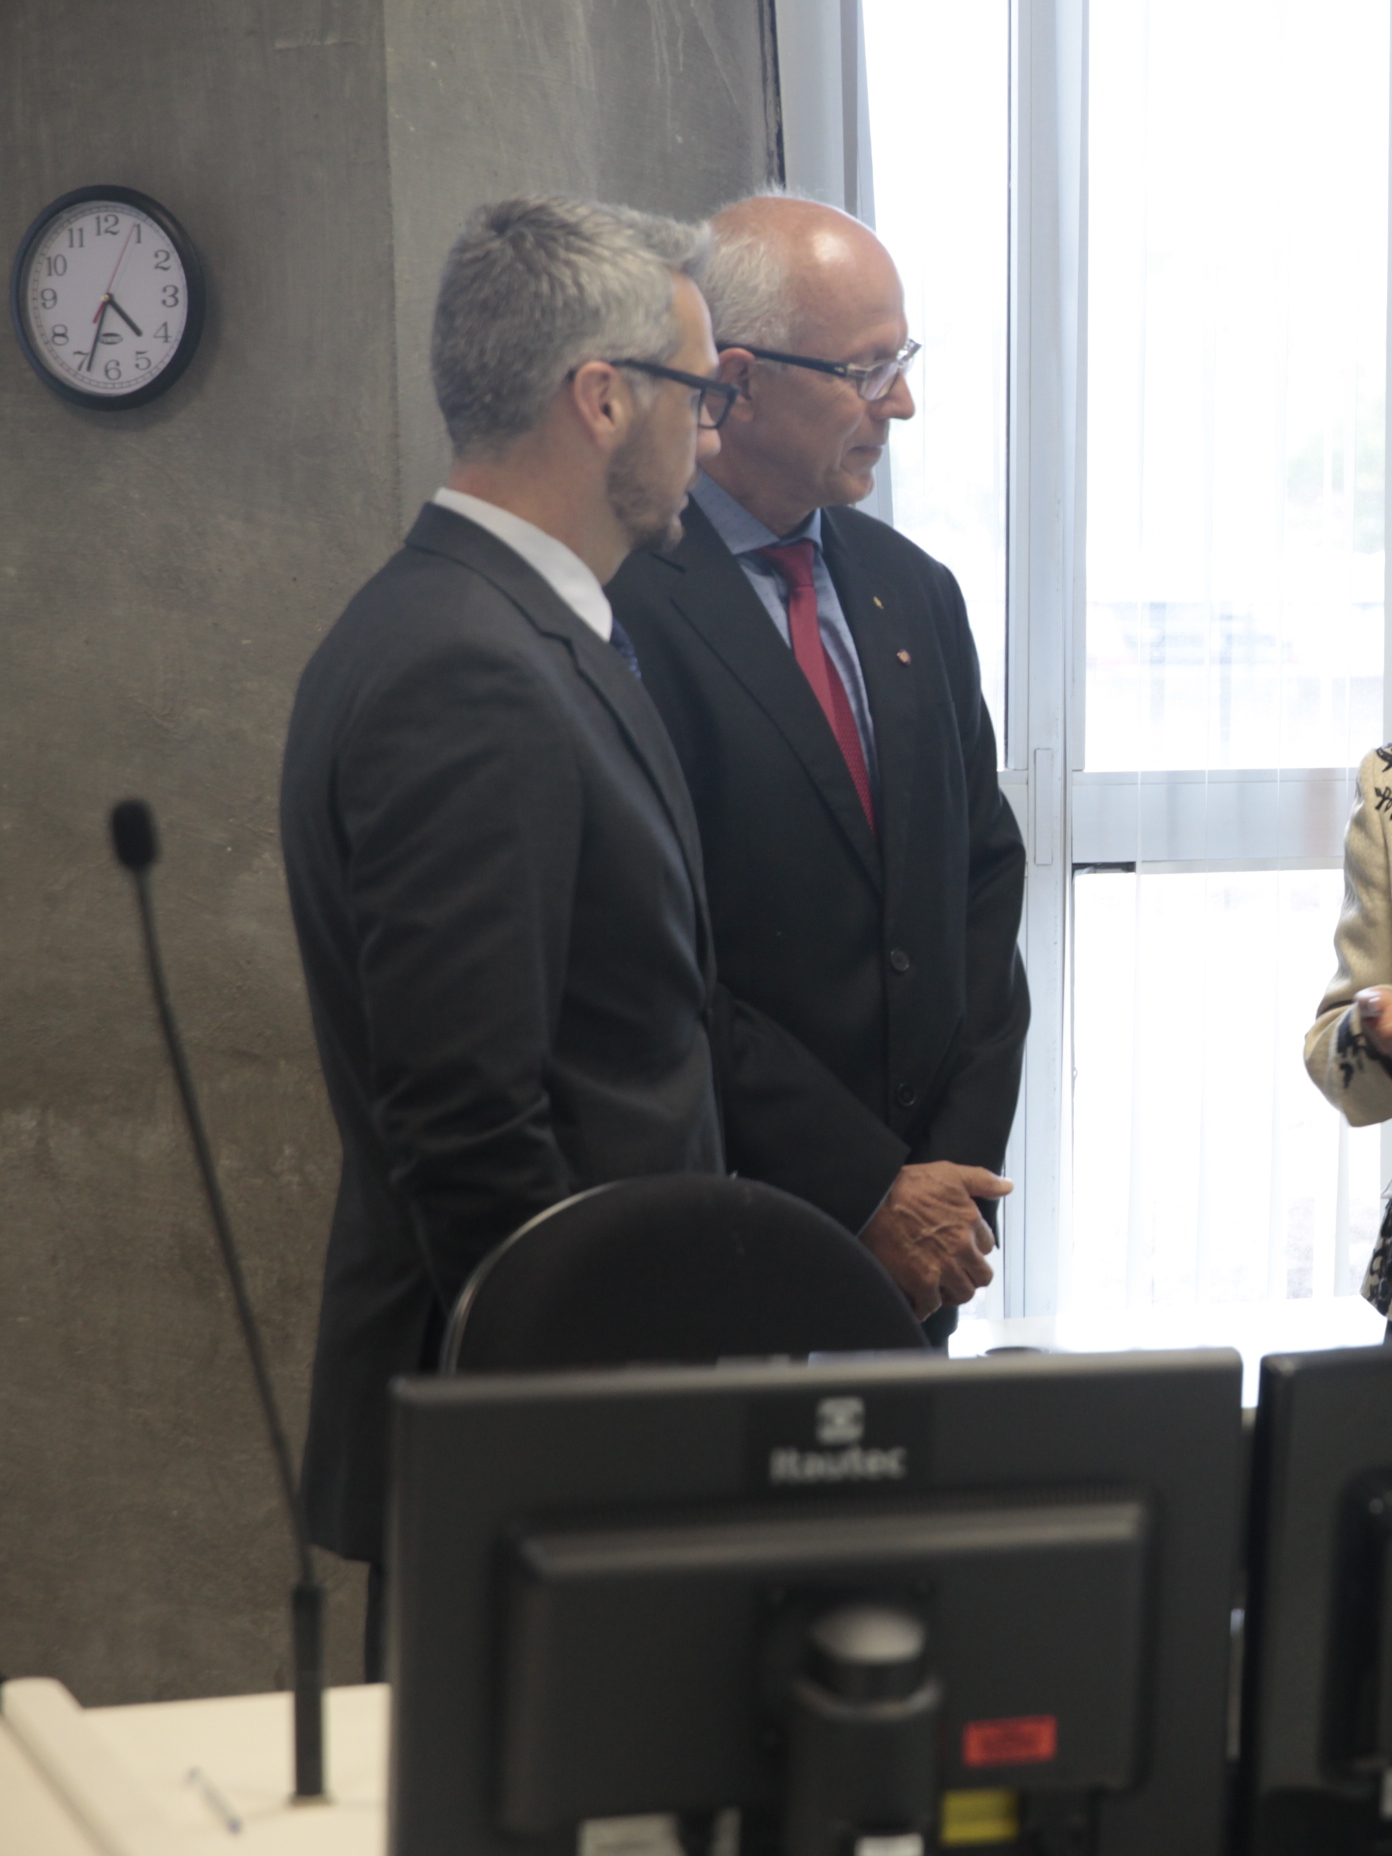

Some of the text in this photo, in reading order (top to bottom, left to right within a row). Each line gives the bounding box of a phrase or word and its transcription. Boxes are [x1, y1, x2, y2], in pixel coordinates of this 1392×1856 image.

[96, 214, 120, 236] 12
[134, 223, 142, 244] 1
[68, 227, 85, 248] 11
[47, 254, 67, 277] 10
[154, 250, 171, 271] 2
[41, 288, 57, 309] 9
[162, 285, 179, 308] 3
[52, 324, 69, 346] 8
[153, 322, 172, 343] 4
[73, 350, 90, 371] 7
[105, 359, 122, 380] 6
[135, 351, 151, 370] 5
[769, 1447, 907, 1485] Itautec
